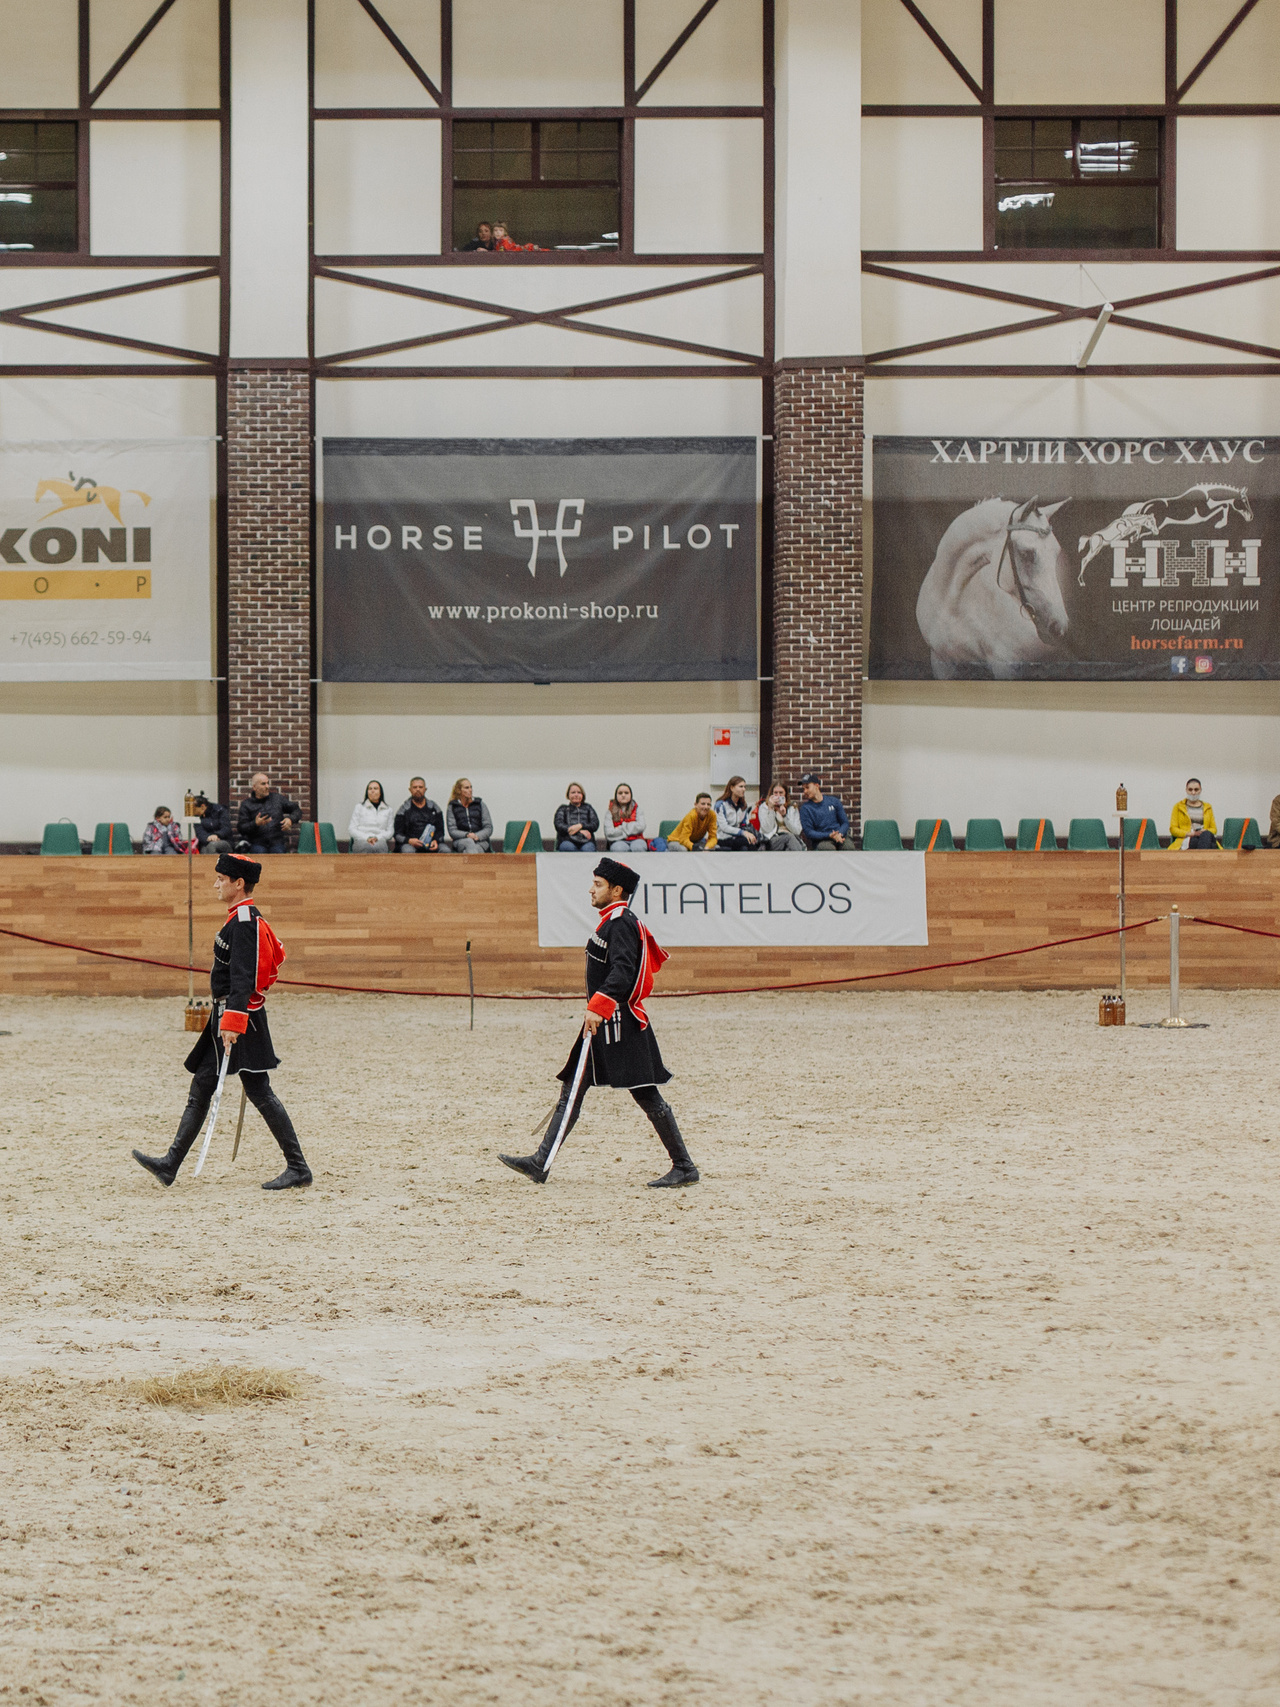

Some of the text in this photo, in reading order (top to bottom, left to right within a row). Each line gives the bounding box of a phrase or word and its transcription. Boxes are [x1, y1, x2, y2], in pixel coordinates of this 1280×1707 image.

[930, 440, 1266, 464] ХАРТЛИ ХОРС ХАУС
[334, 523, 740, 551] HORSE PILOT
[428, 601, 660, 622] www.prokoni-shop.ru
[1112, 600, 1260, 615] ЦЕНТР РЕПРОДУКЦИИ
[1150, 616, 1221, 633] ЛОШАДЕЙ
[9, 631, 67, 648] +7(495)
[70, 630, 152, 646] 662-59-94
[1130, 635, 1244, 650] horsefarm.ru
